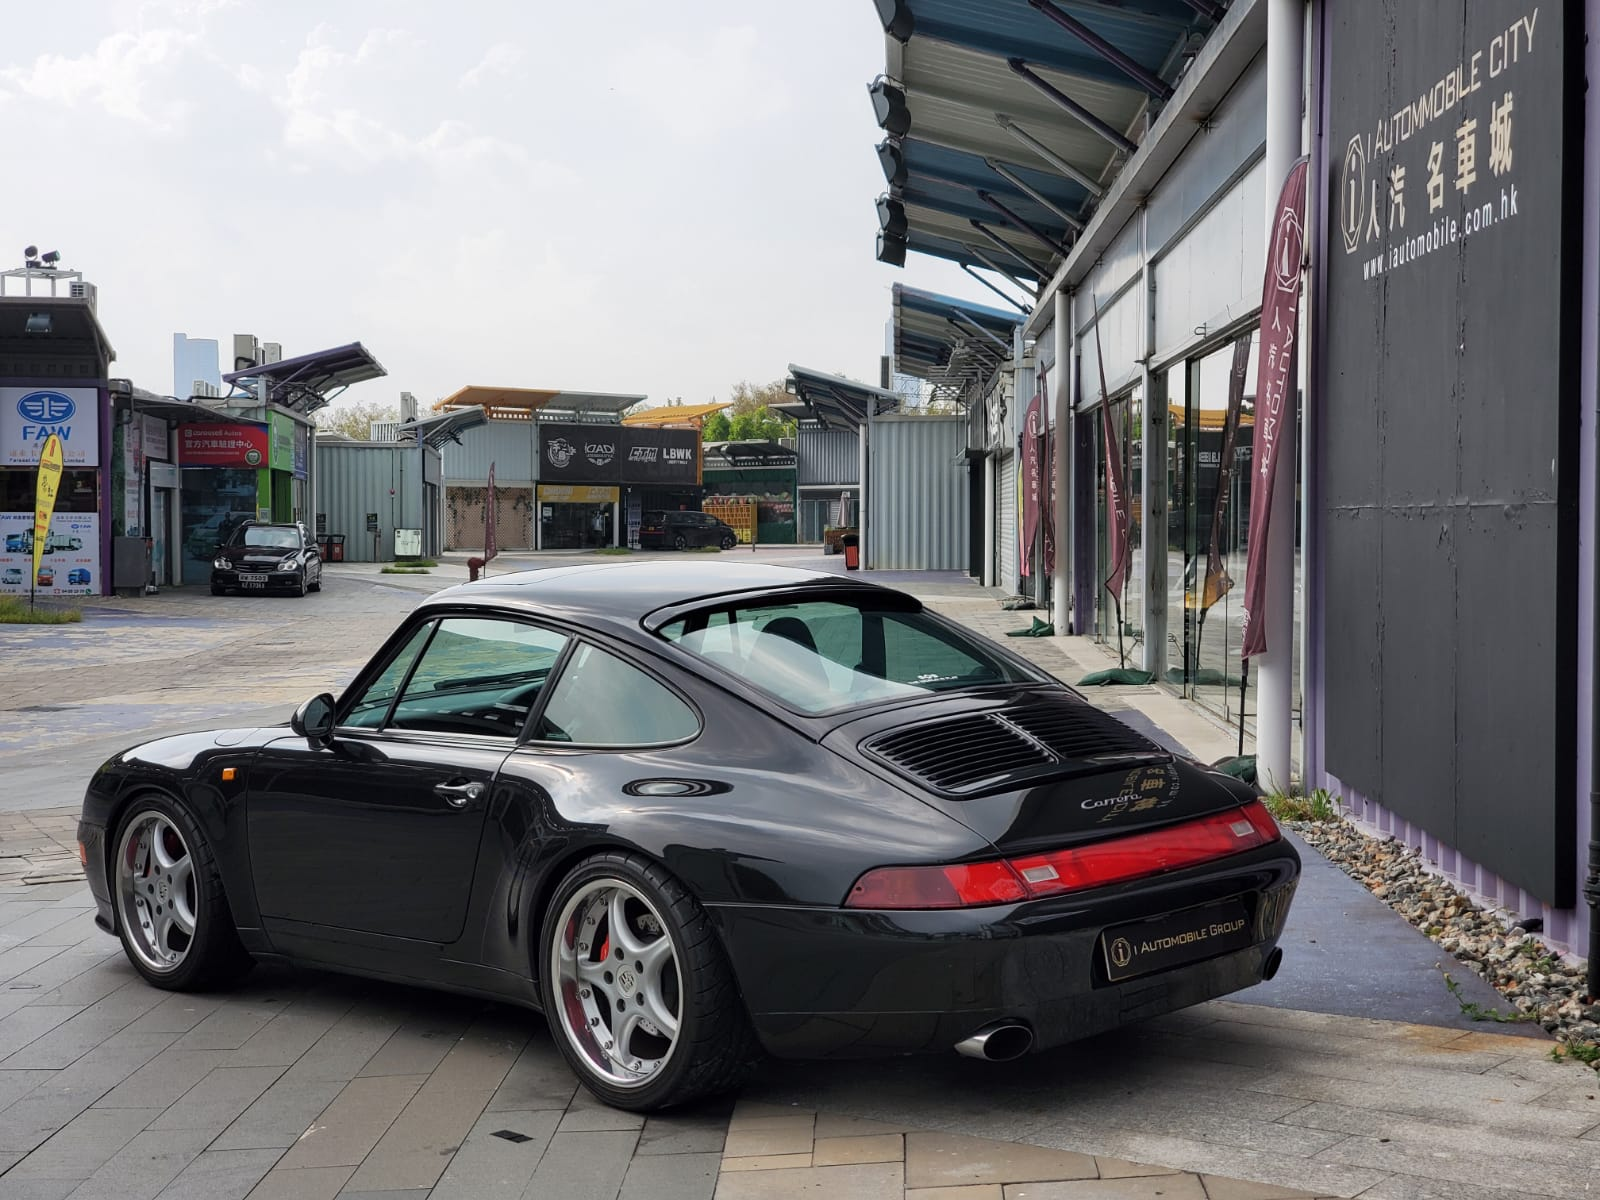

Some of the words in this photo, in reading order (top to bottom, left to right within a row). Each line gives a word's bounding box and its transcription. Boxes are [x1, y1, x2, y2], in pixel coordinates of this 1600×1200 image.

[1374, 50, 1482, 160] AUTOMMOBILE
[1489, 8, 1538, 79] CITY
[1363, 184, 1518, 280] www.iautomobile.com.hk
[22, 425, 72, 441] FAW
[663, 448, 692, 460] LBWK
[1081, 794, 1142, 810] Carrera
[1141, 928, 1208, 954] AUTOMOBILE
[1209, 919, 1245, 936] GROUP
